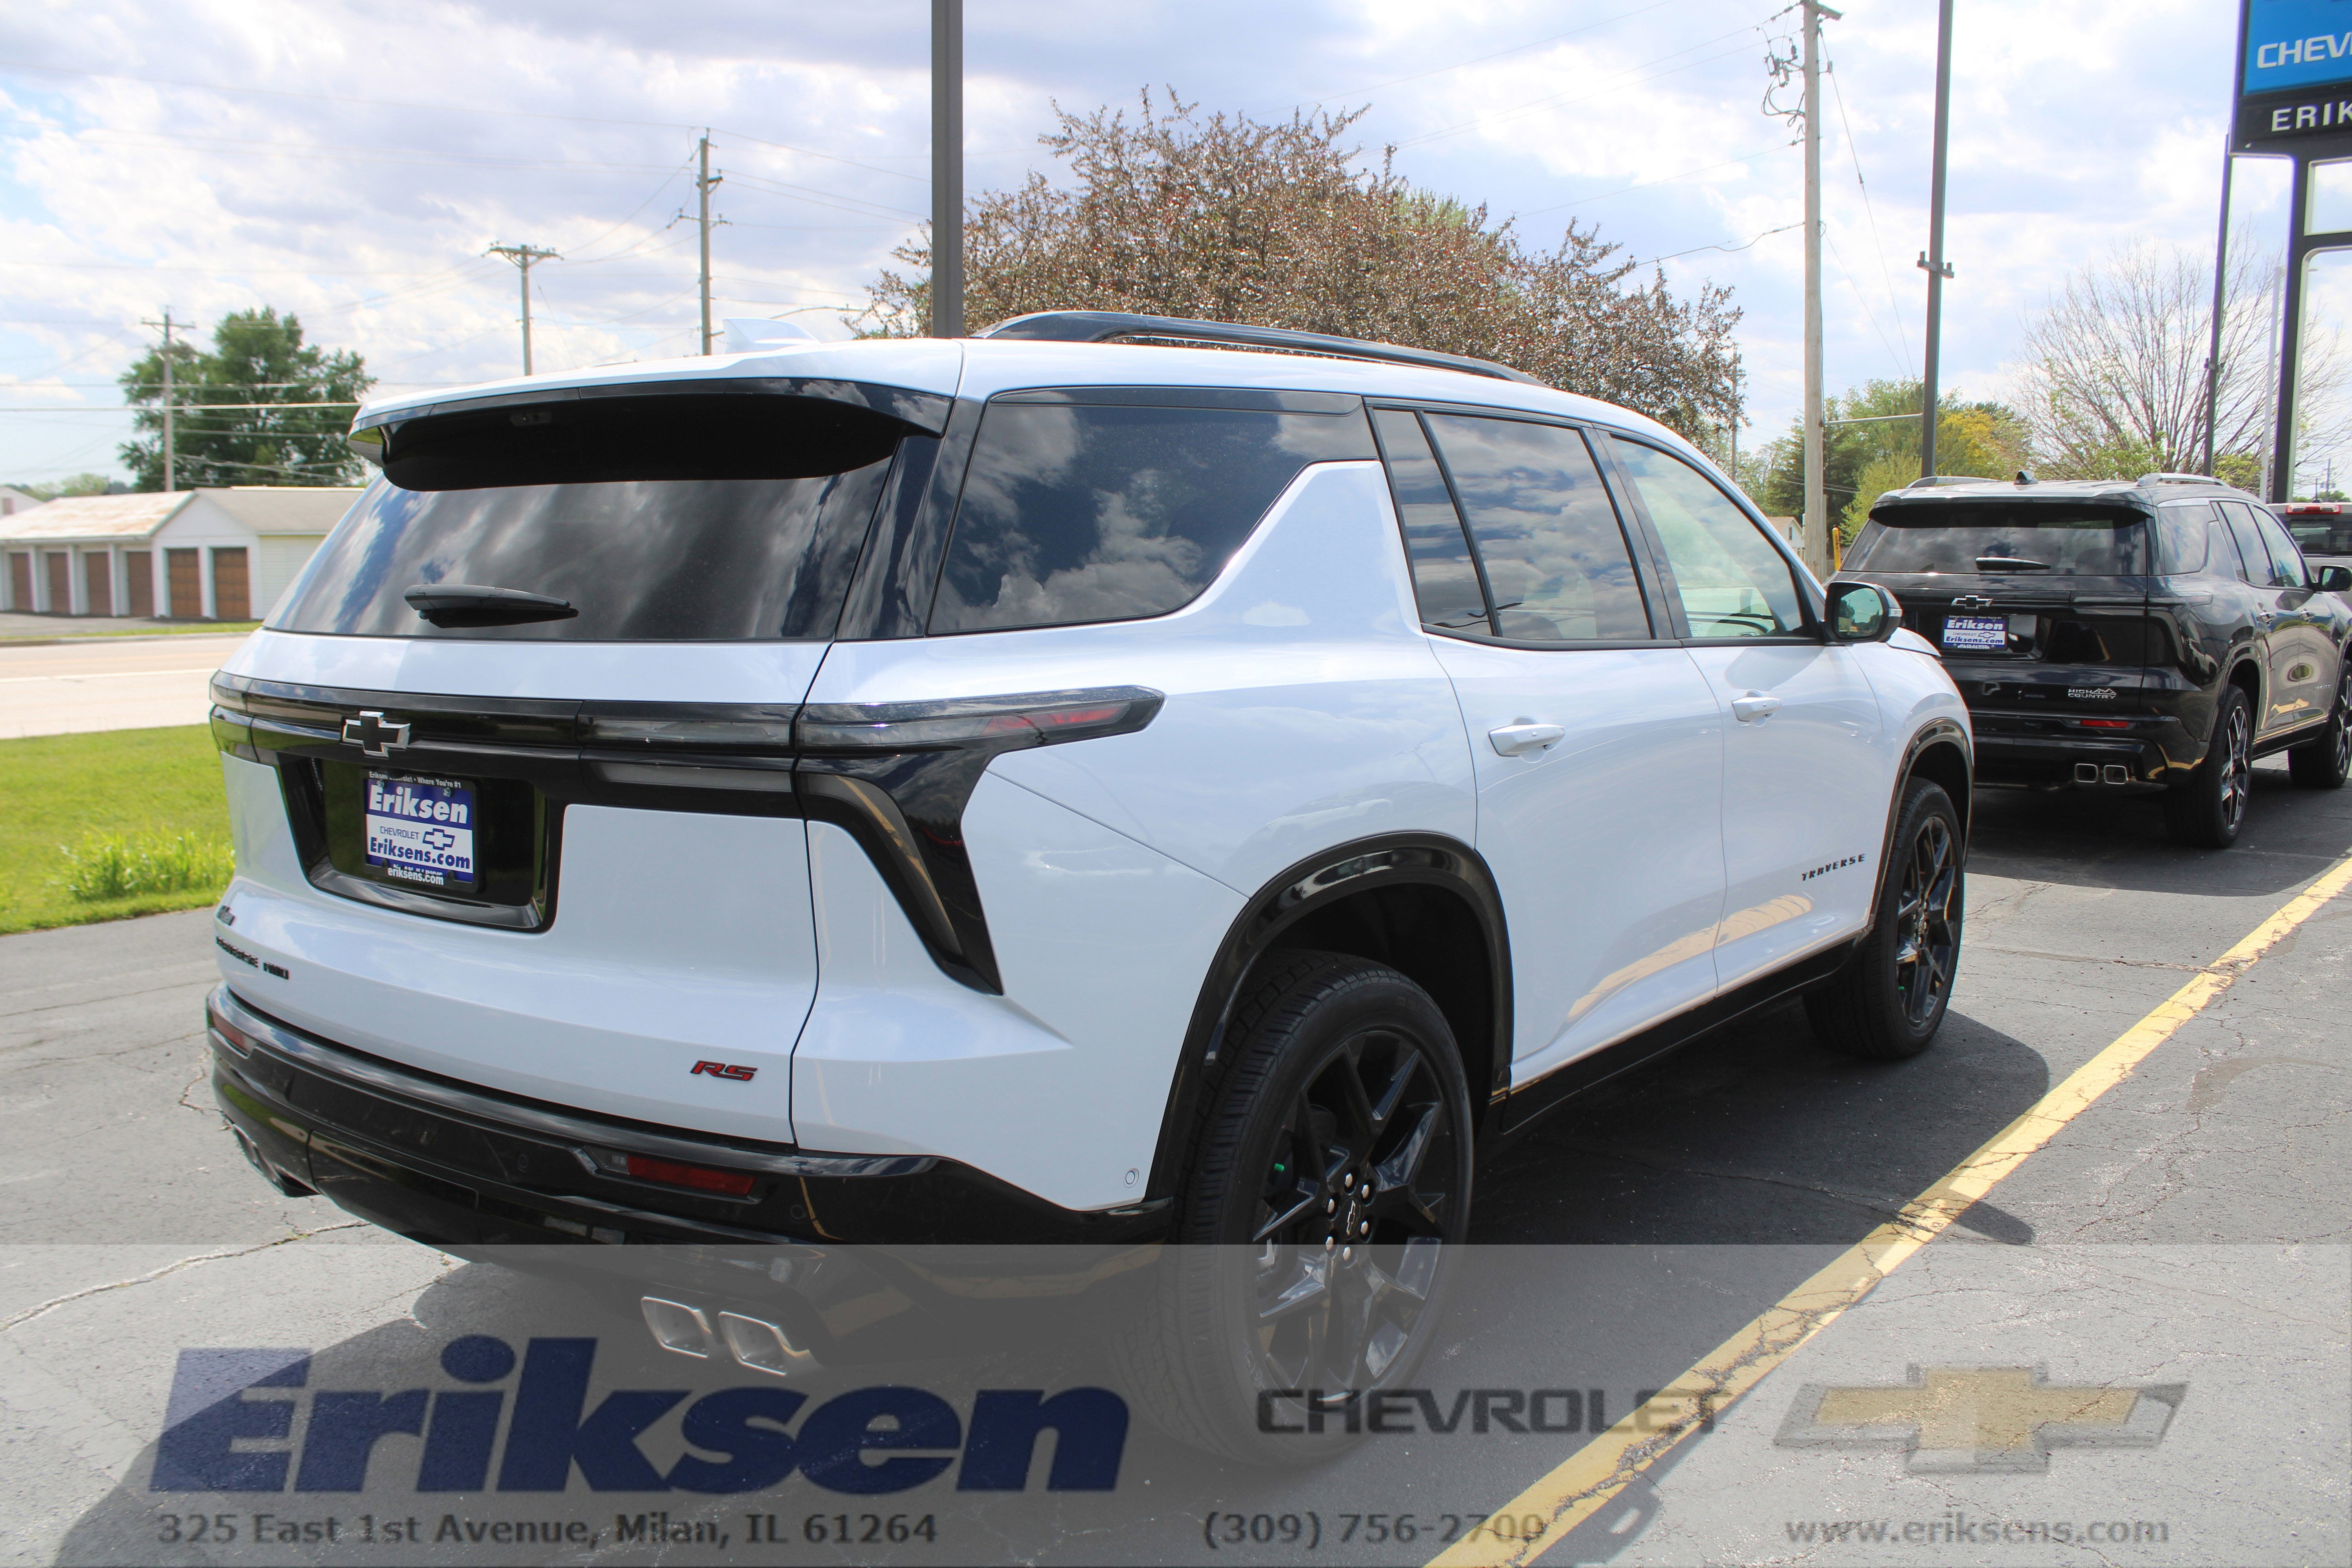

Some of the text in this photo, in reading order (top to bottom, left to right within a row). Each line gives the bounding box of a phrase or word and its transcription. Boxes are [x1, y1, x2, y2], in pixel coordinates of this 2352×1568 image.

[2257, 31, 2352, 69] CHEV
[1947, 619, 2003, 630] Eriksen
[369, 771, 388, 780] Eriksen
[417, 777, 435, 785] Where
[435, 778, 453, 787] You're
[369, 784, 468, 824] Eriksen
[380, 826, 420, 840] CHEVROLET
[370, 837, 470, 870] Eriksens.com
[388, 866, 444, 886] eriksens.com
[1802, 853, 1865, 881] TRAVERSE
[690, 1060, 758, 1081] RS
